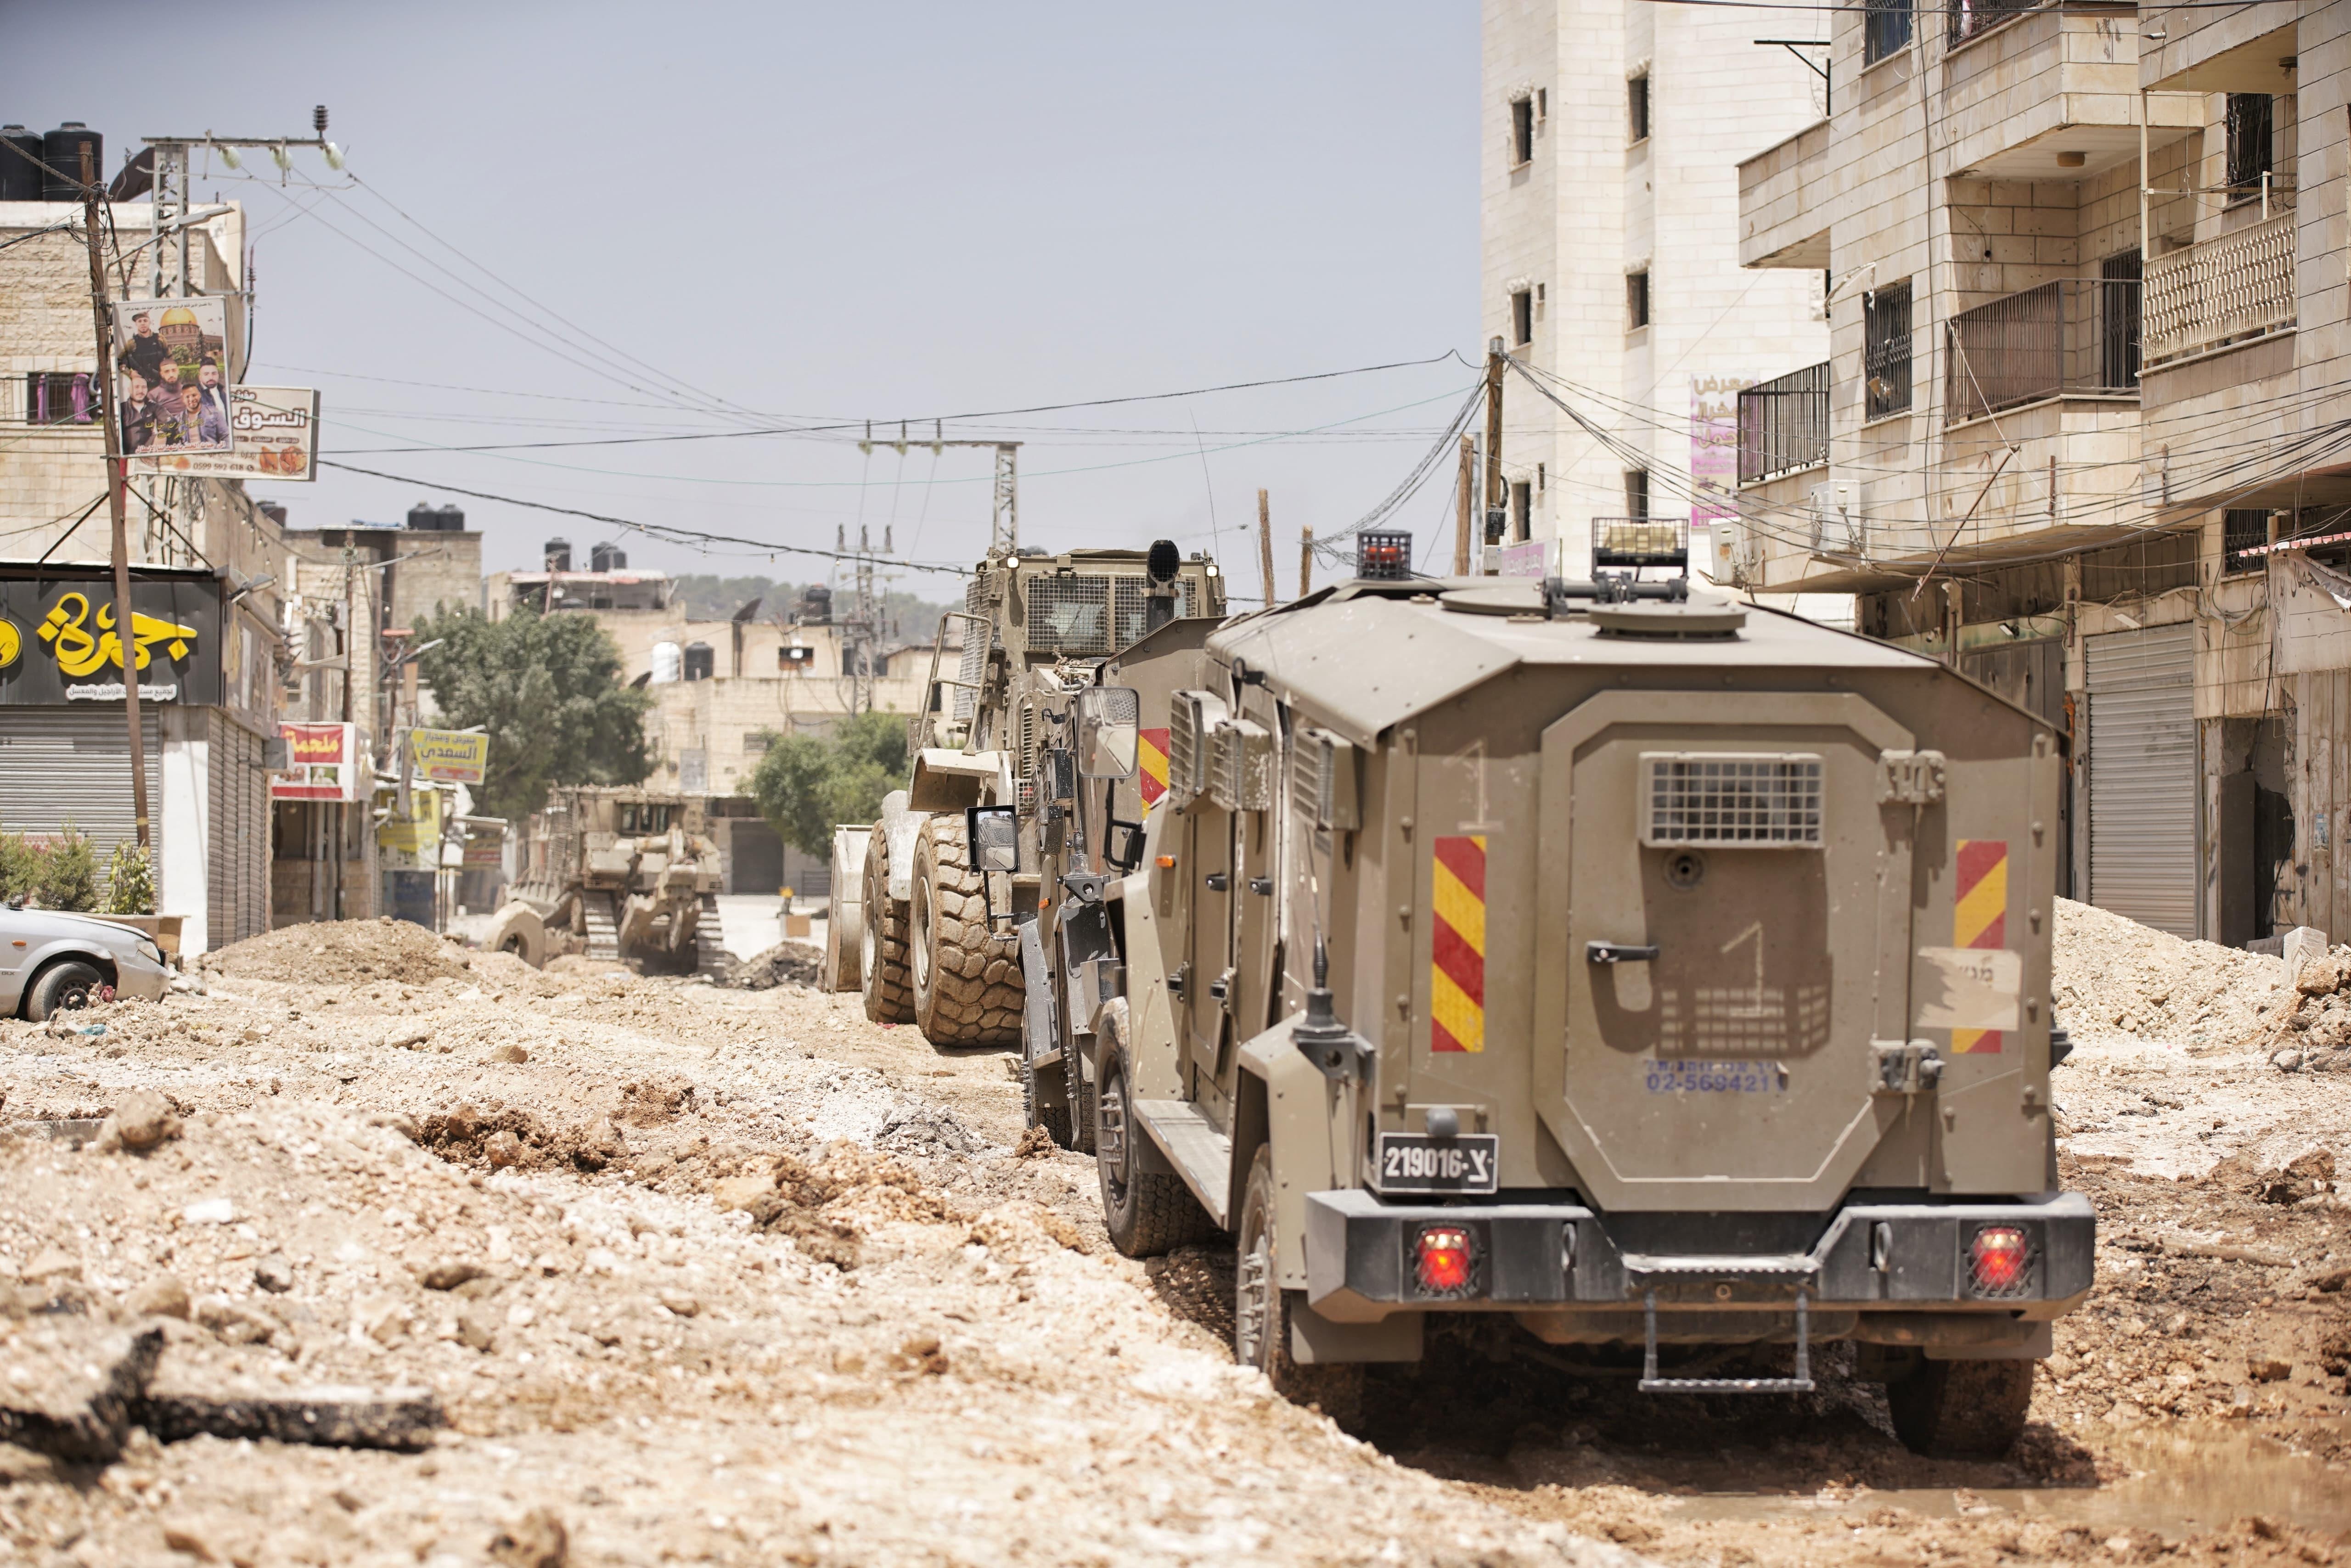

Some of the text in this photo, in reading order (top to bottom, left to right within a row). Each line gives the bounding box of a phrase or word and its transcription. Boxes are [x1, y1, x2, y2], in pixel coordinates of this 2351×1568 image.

[1694, 374, 1753, 395] معرض
[233, 407, 307, 430] السوق
[155, 687, 173, 696] لجميع
[284, 731, 338, 753] ملحمة
[421, 746, 478, 762] السعدي
